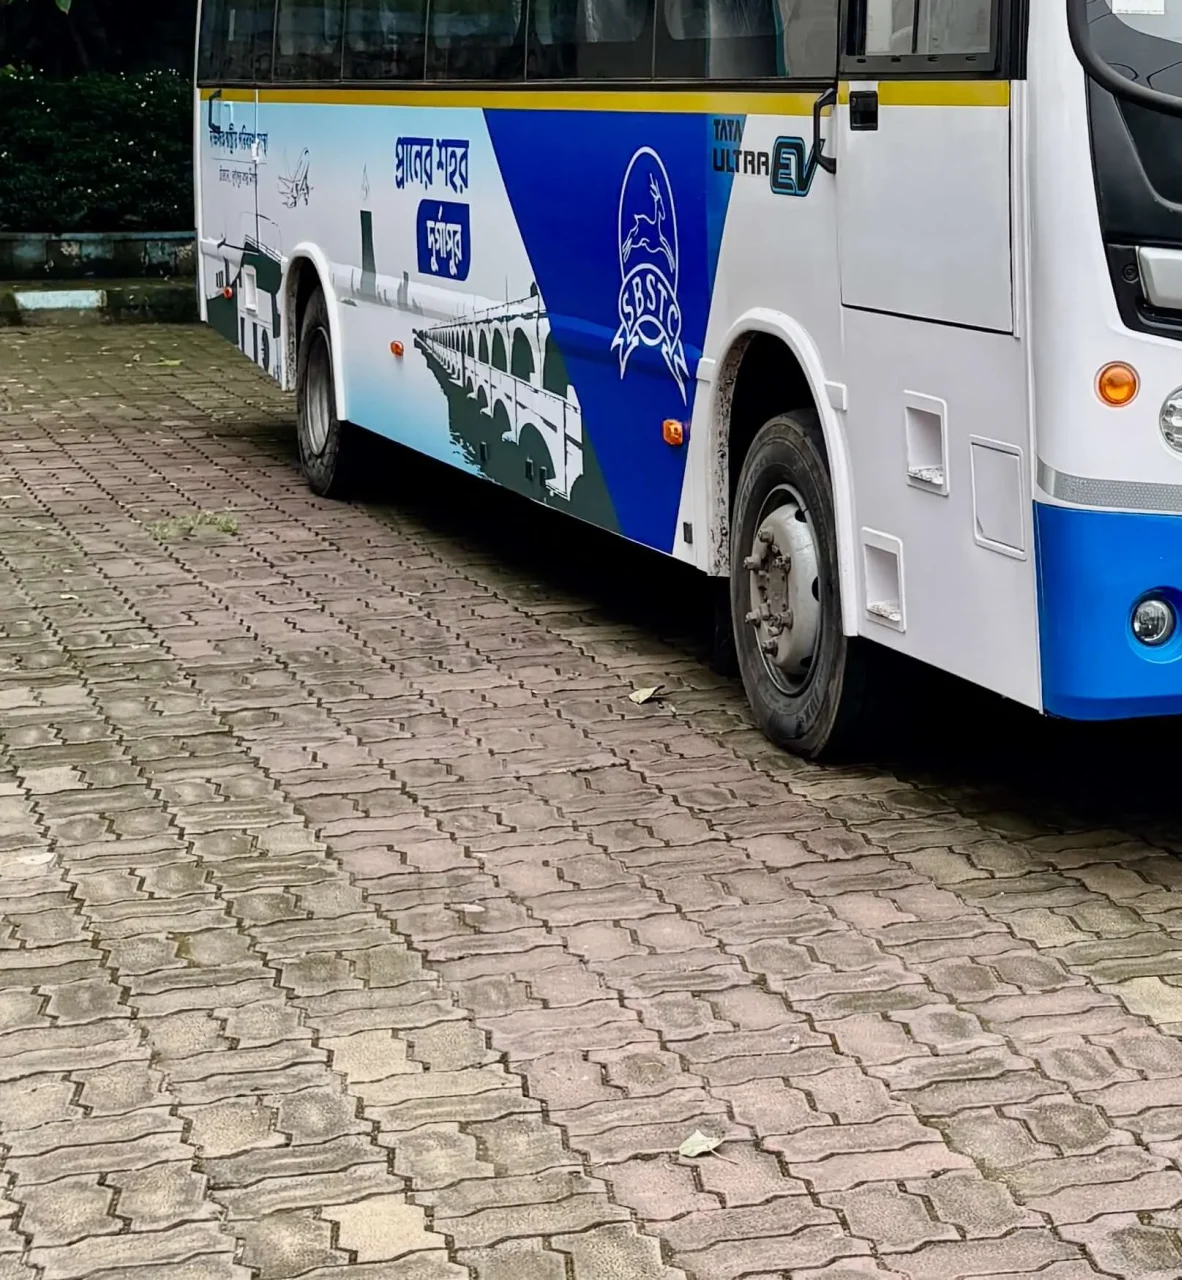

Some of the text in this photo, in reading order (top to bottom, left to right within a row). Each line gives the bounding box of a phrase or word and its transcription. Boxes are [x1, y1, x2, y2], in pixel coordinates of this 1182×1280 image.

[713, 119, 742, 142] TATA
[436, 138, 470, 194] শহর
[713, 136, 826, 197] ULTRA EV
[622, 273, 679, 337] SBSTC
